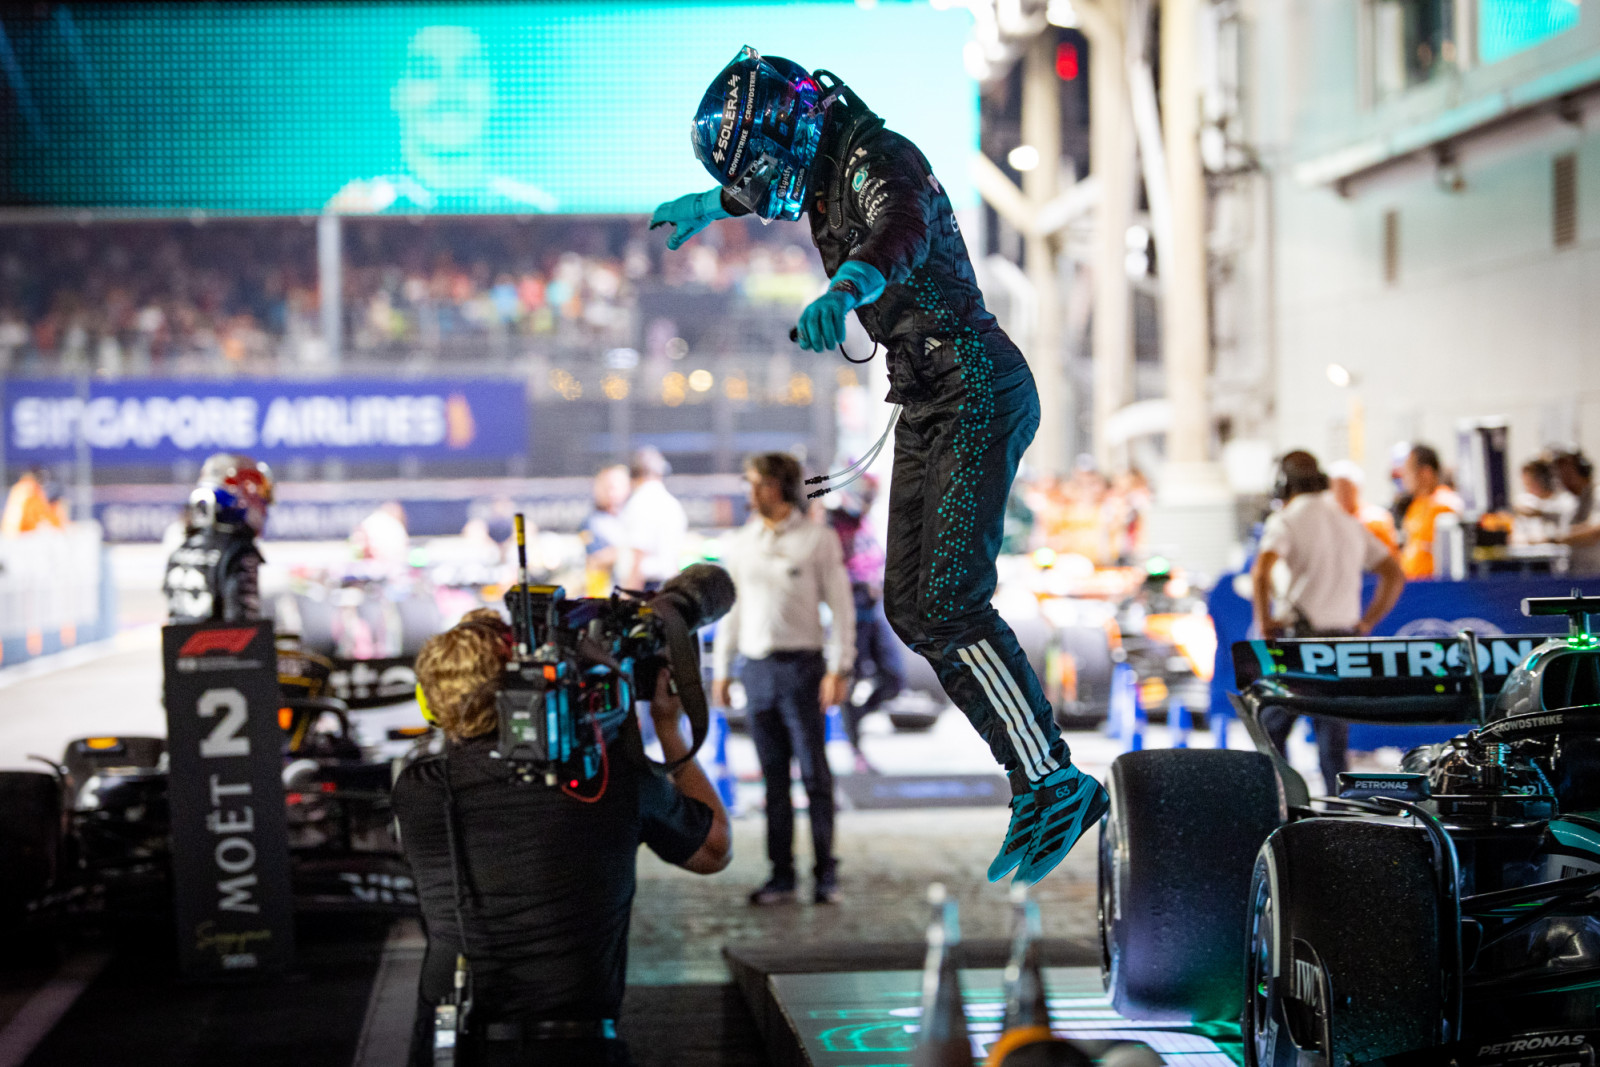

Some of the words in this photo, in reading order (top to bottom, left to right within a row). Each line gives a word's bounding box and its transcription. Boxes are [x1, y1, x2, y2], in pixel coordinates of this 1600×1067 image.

[717, 86, 739, 151] SOLERA
[728, 129, 749, 175] CROWDSTRIKE
[13, 396, 258, 449] SINGAPORE
[262, 396, 445, 448] AIRLINES
[1300, 640, 1534, 678] PETRON
[198, 687, 250, 759] 2
[1055, 785, 1070, 798] 63
[1355, 780, 1408, 790] PETRONAS
[1477, 1034, 1587, 1057] PETRONAS
